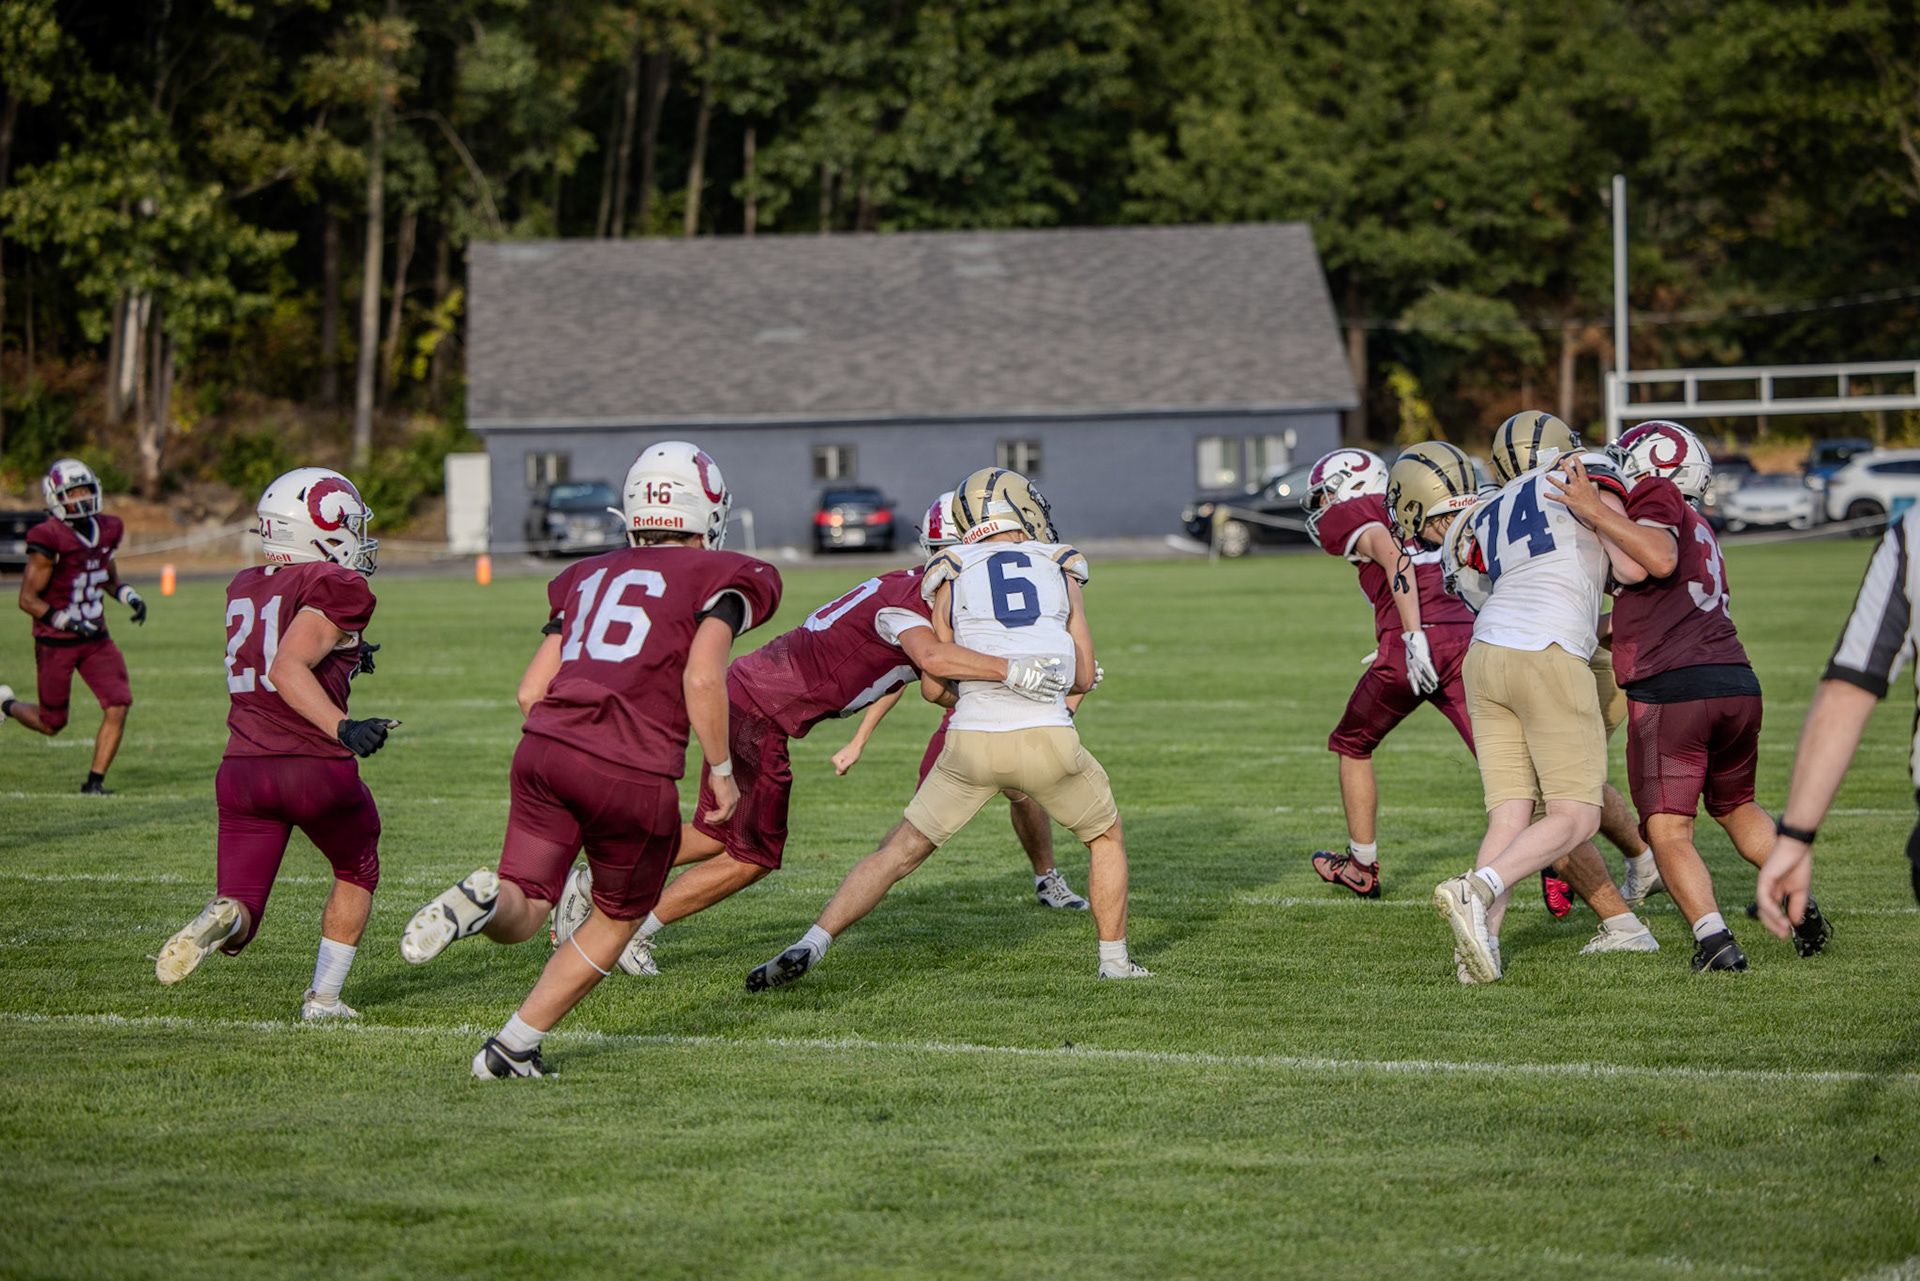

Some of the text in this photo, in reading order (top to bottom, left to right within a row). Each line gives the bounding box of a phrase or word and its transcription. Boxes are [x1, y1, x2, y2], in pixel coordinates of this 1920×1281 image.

[633, 516, 683, 528] Riddell
[646, 482, 672, 504] 16
[964, 521, 999, 544] Riddell
[1475, 476, 1557, 587] 74
[70, 570, 109, 621] 15
[561, 568, 667, 663] 16
[987, 551, 1041, 628] 6
[225, 595, 282, 694] 21
